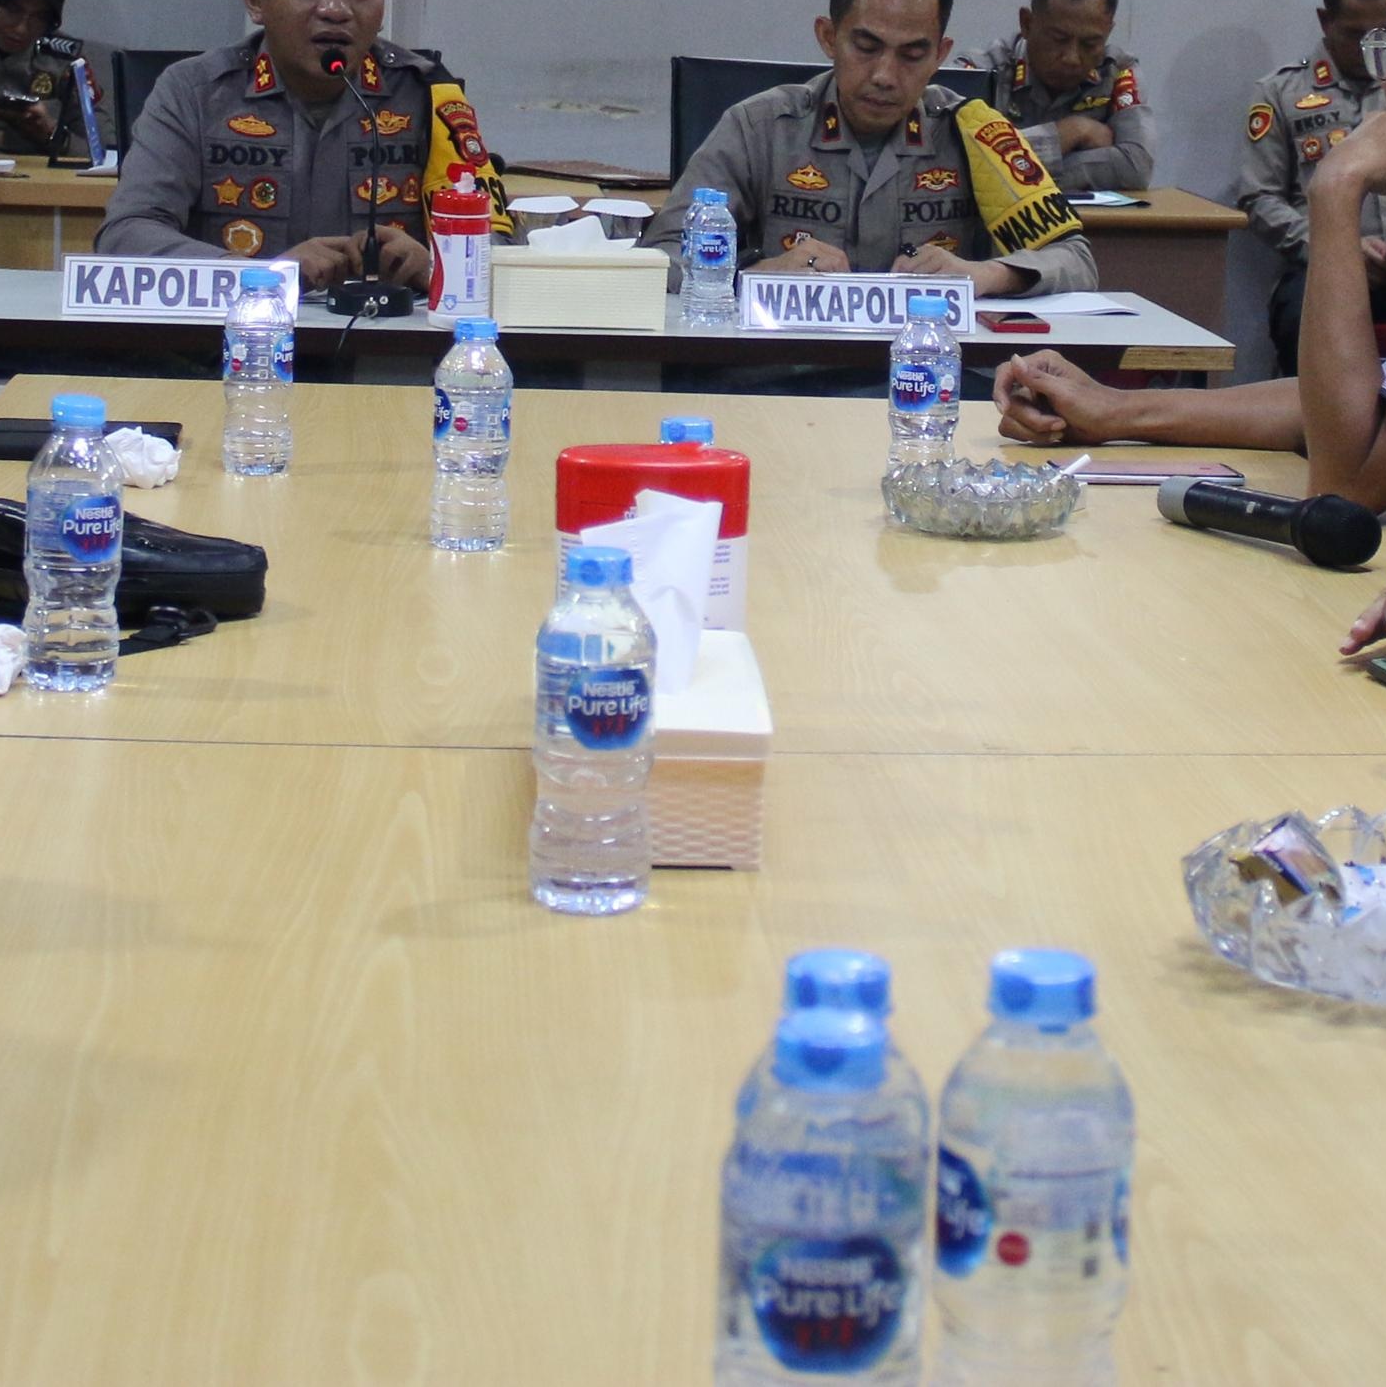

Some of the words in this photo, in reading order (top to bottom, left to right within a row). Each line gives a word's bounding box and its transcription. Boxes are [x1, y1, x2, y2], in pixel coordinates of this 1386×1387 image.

[210, 143, 289, 167] DODY
[772, 194, 841, 223] RIKO
[75, 264, 286, 309] KAPOLR
[757, 283, 962, 326] WAKAPOLS
[914, 381, 936, 397] Life
[63, 519, 102, 535] Pure
[568, 695, 618, 716] Pure
[620, 694, 648, 722] Life
